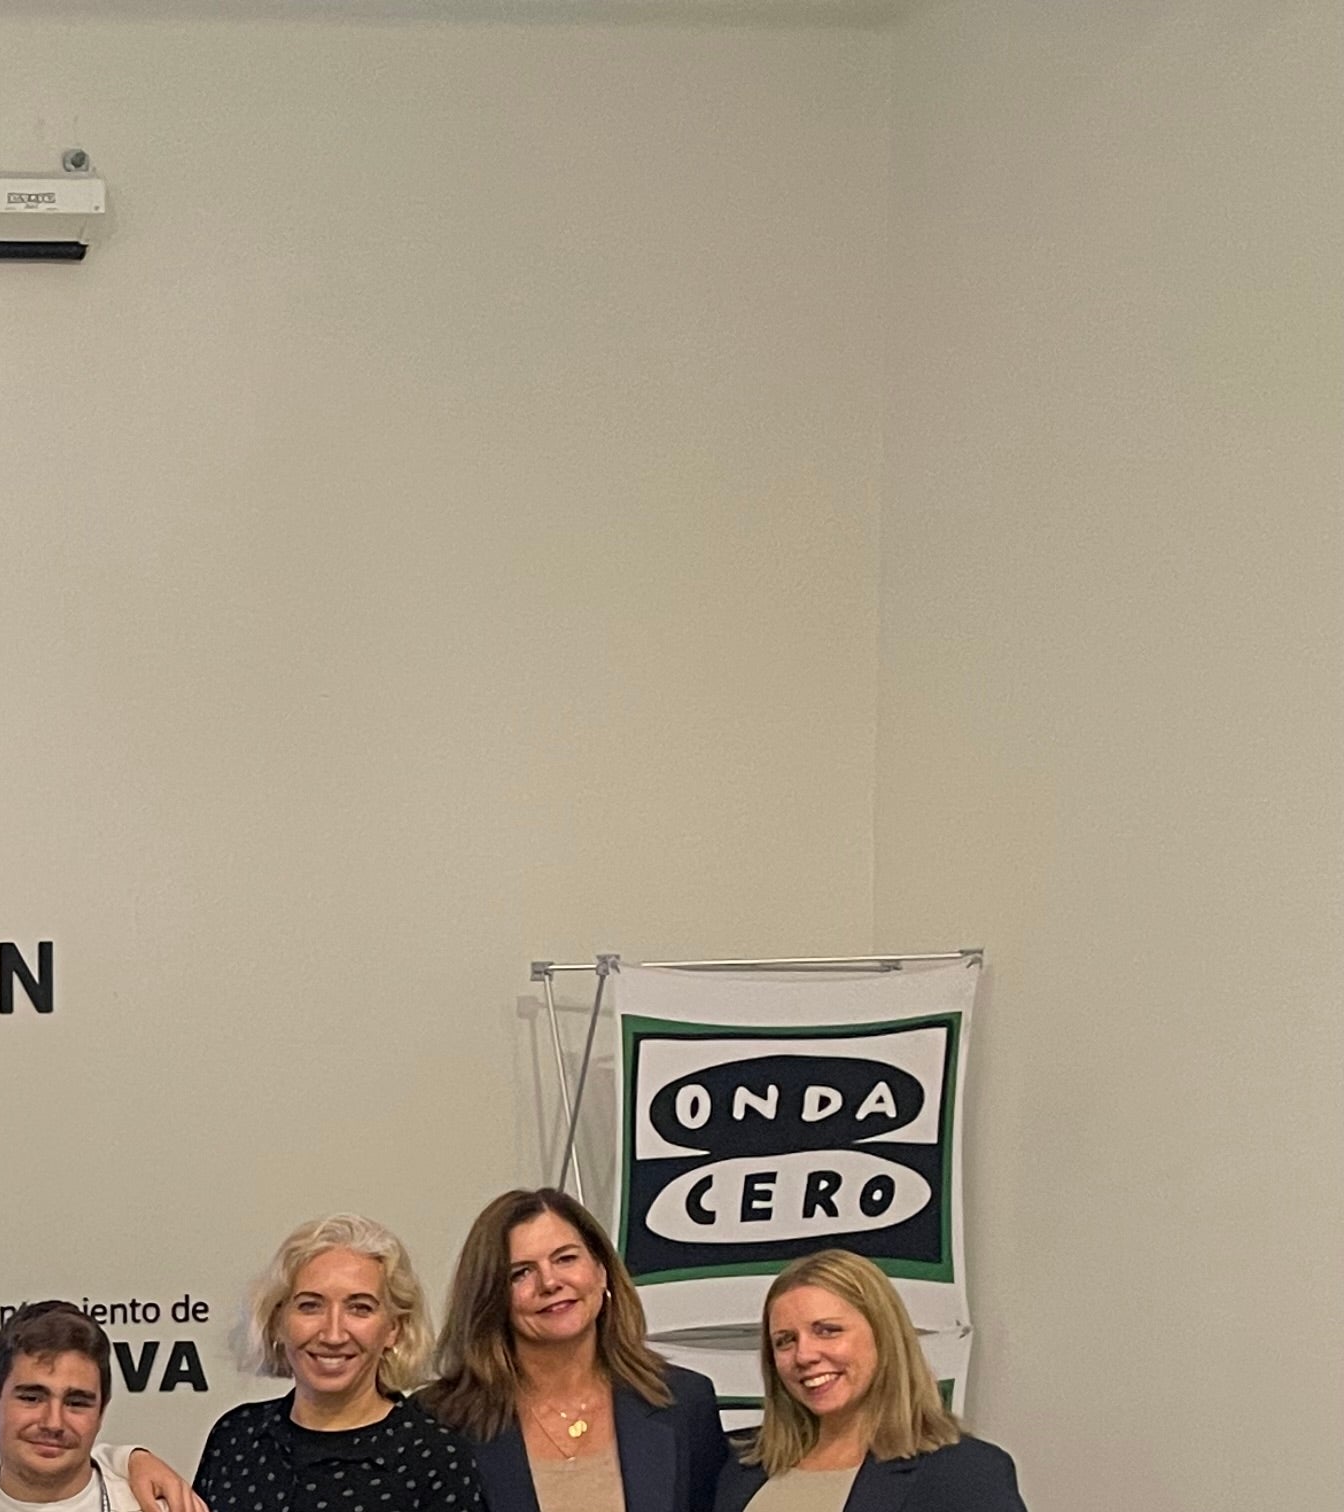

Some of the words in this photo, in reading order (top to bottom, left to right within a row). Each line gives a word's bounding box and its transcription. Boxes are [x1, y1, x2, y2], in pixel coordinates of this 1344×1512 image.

[674, 1080, 898, 1130] ONDA
[684, 1169, 896, 1226] CERO
[171, 1293, 210, 1324] de
